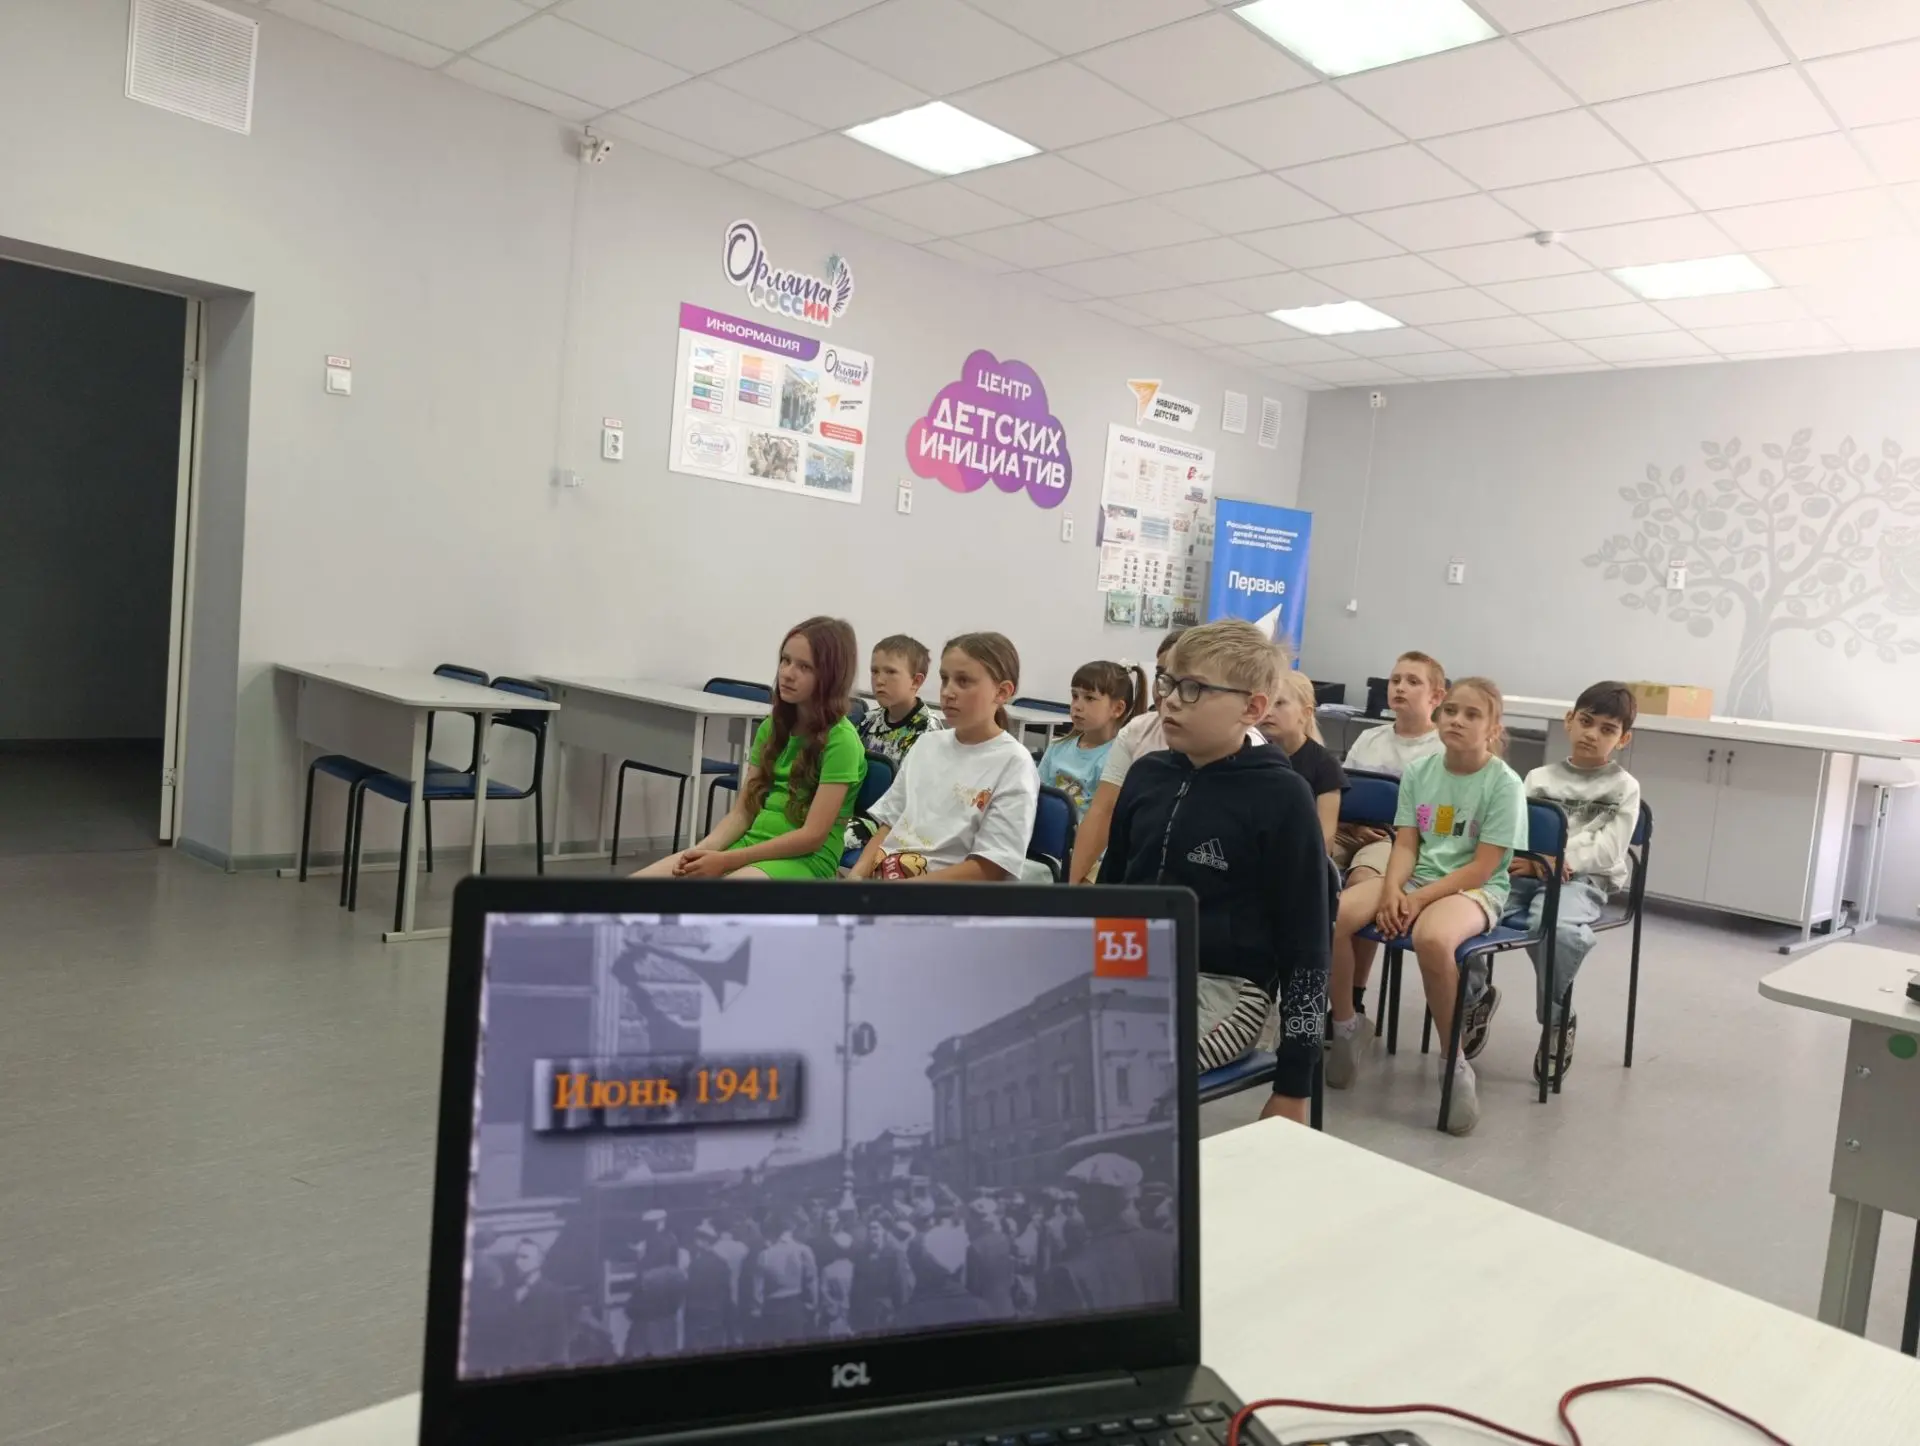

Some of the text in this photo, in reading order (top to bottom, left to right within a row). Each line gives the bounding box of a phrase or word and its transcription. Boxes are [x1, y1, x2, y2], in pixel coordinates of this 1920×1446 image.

[752, 284, 830, 322] РОССИИ
[705, 315, 801, 353] ИНФОРМАЦИЯ
[976, 369, 1032, 401] ЦЕНТР
[932, 398, 1063, 458] ДЕТСКИХ
[919, 428, 1066, 489] ИНИЦИАТИВ
[1228, 570, 1286, 597] Первые
[553, 1066, 782, 1110] Июнь 1941
